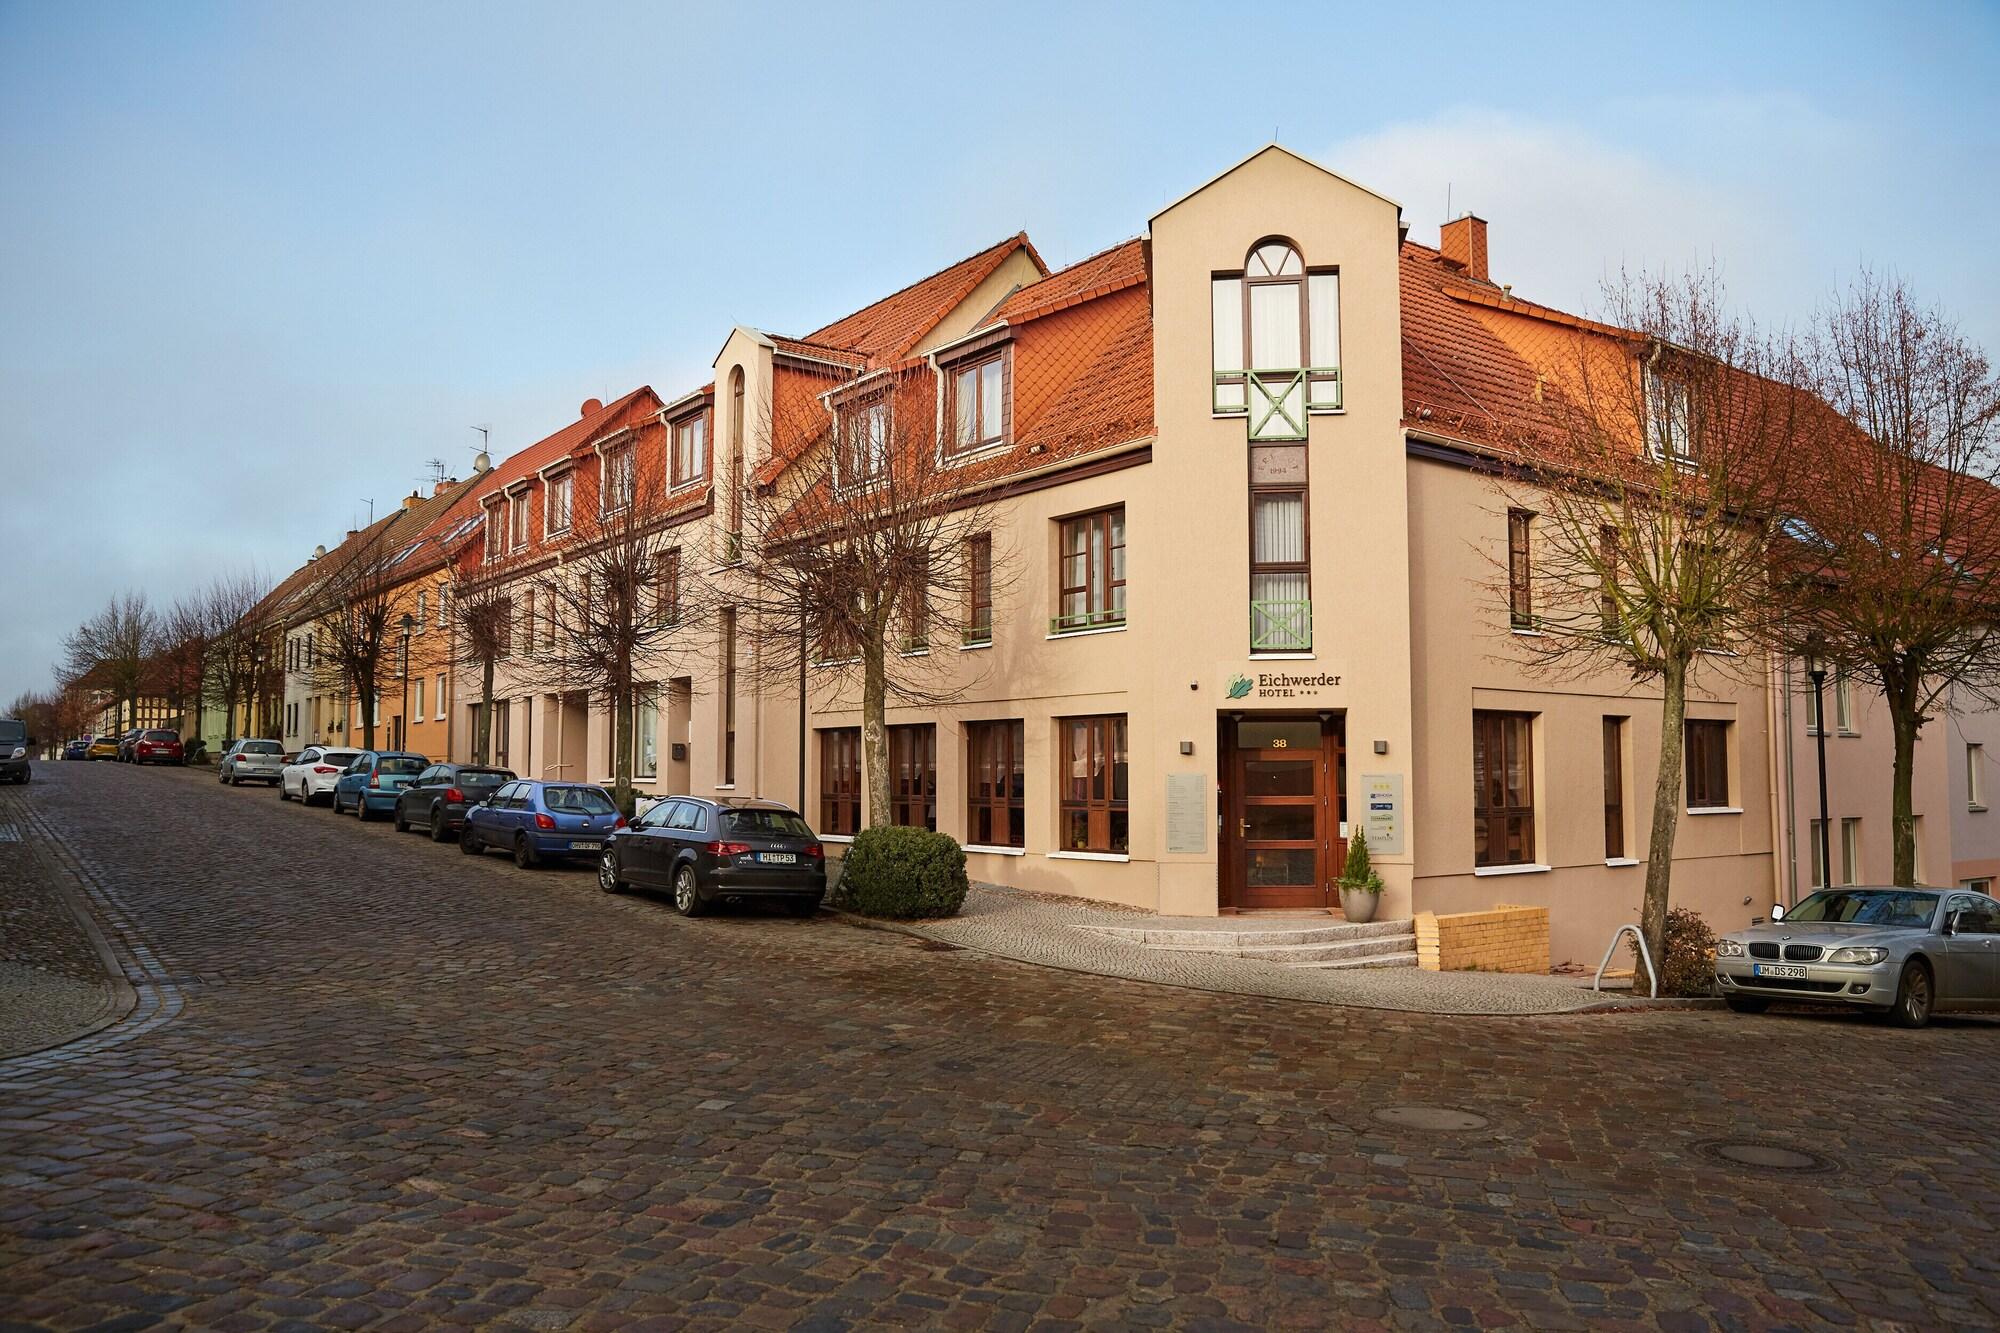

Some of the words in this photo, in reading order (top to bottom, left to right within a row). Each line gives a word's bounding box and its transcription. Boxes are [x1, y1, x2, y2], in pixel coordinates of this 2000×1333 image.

[1259, 673, 1341, 686] Eichwerder
[1259, 689, 1295, 697] HOTEL
[1273, 739, 1287, 748] 38
[1759, 966, 1769, 975] UM
[1774, 967, 1786, 976] DS
[1787, 968, 1805, 977] 298
